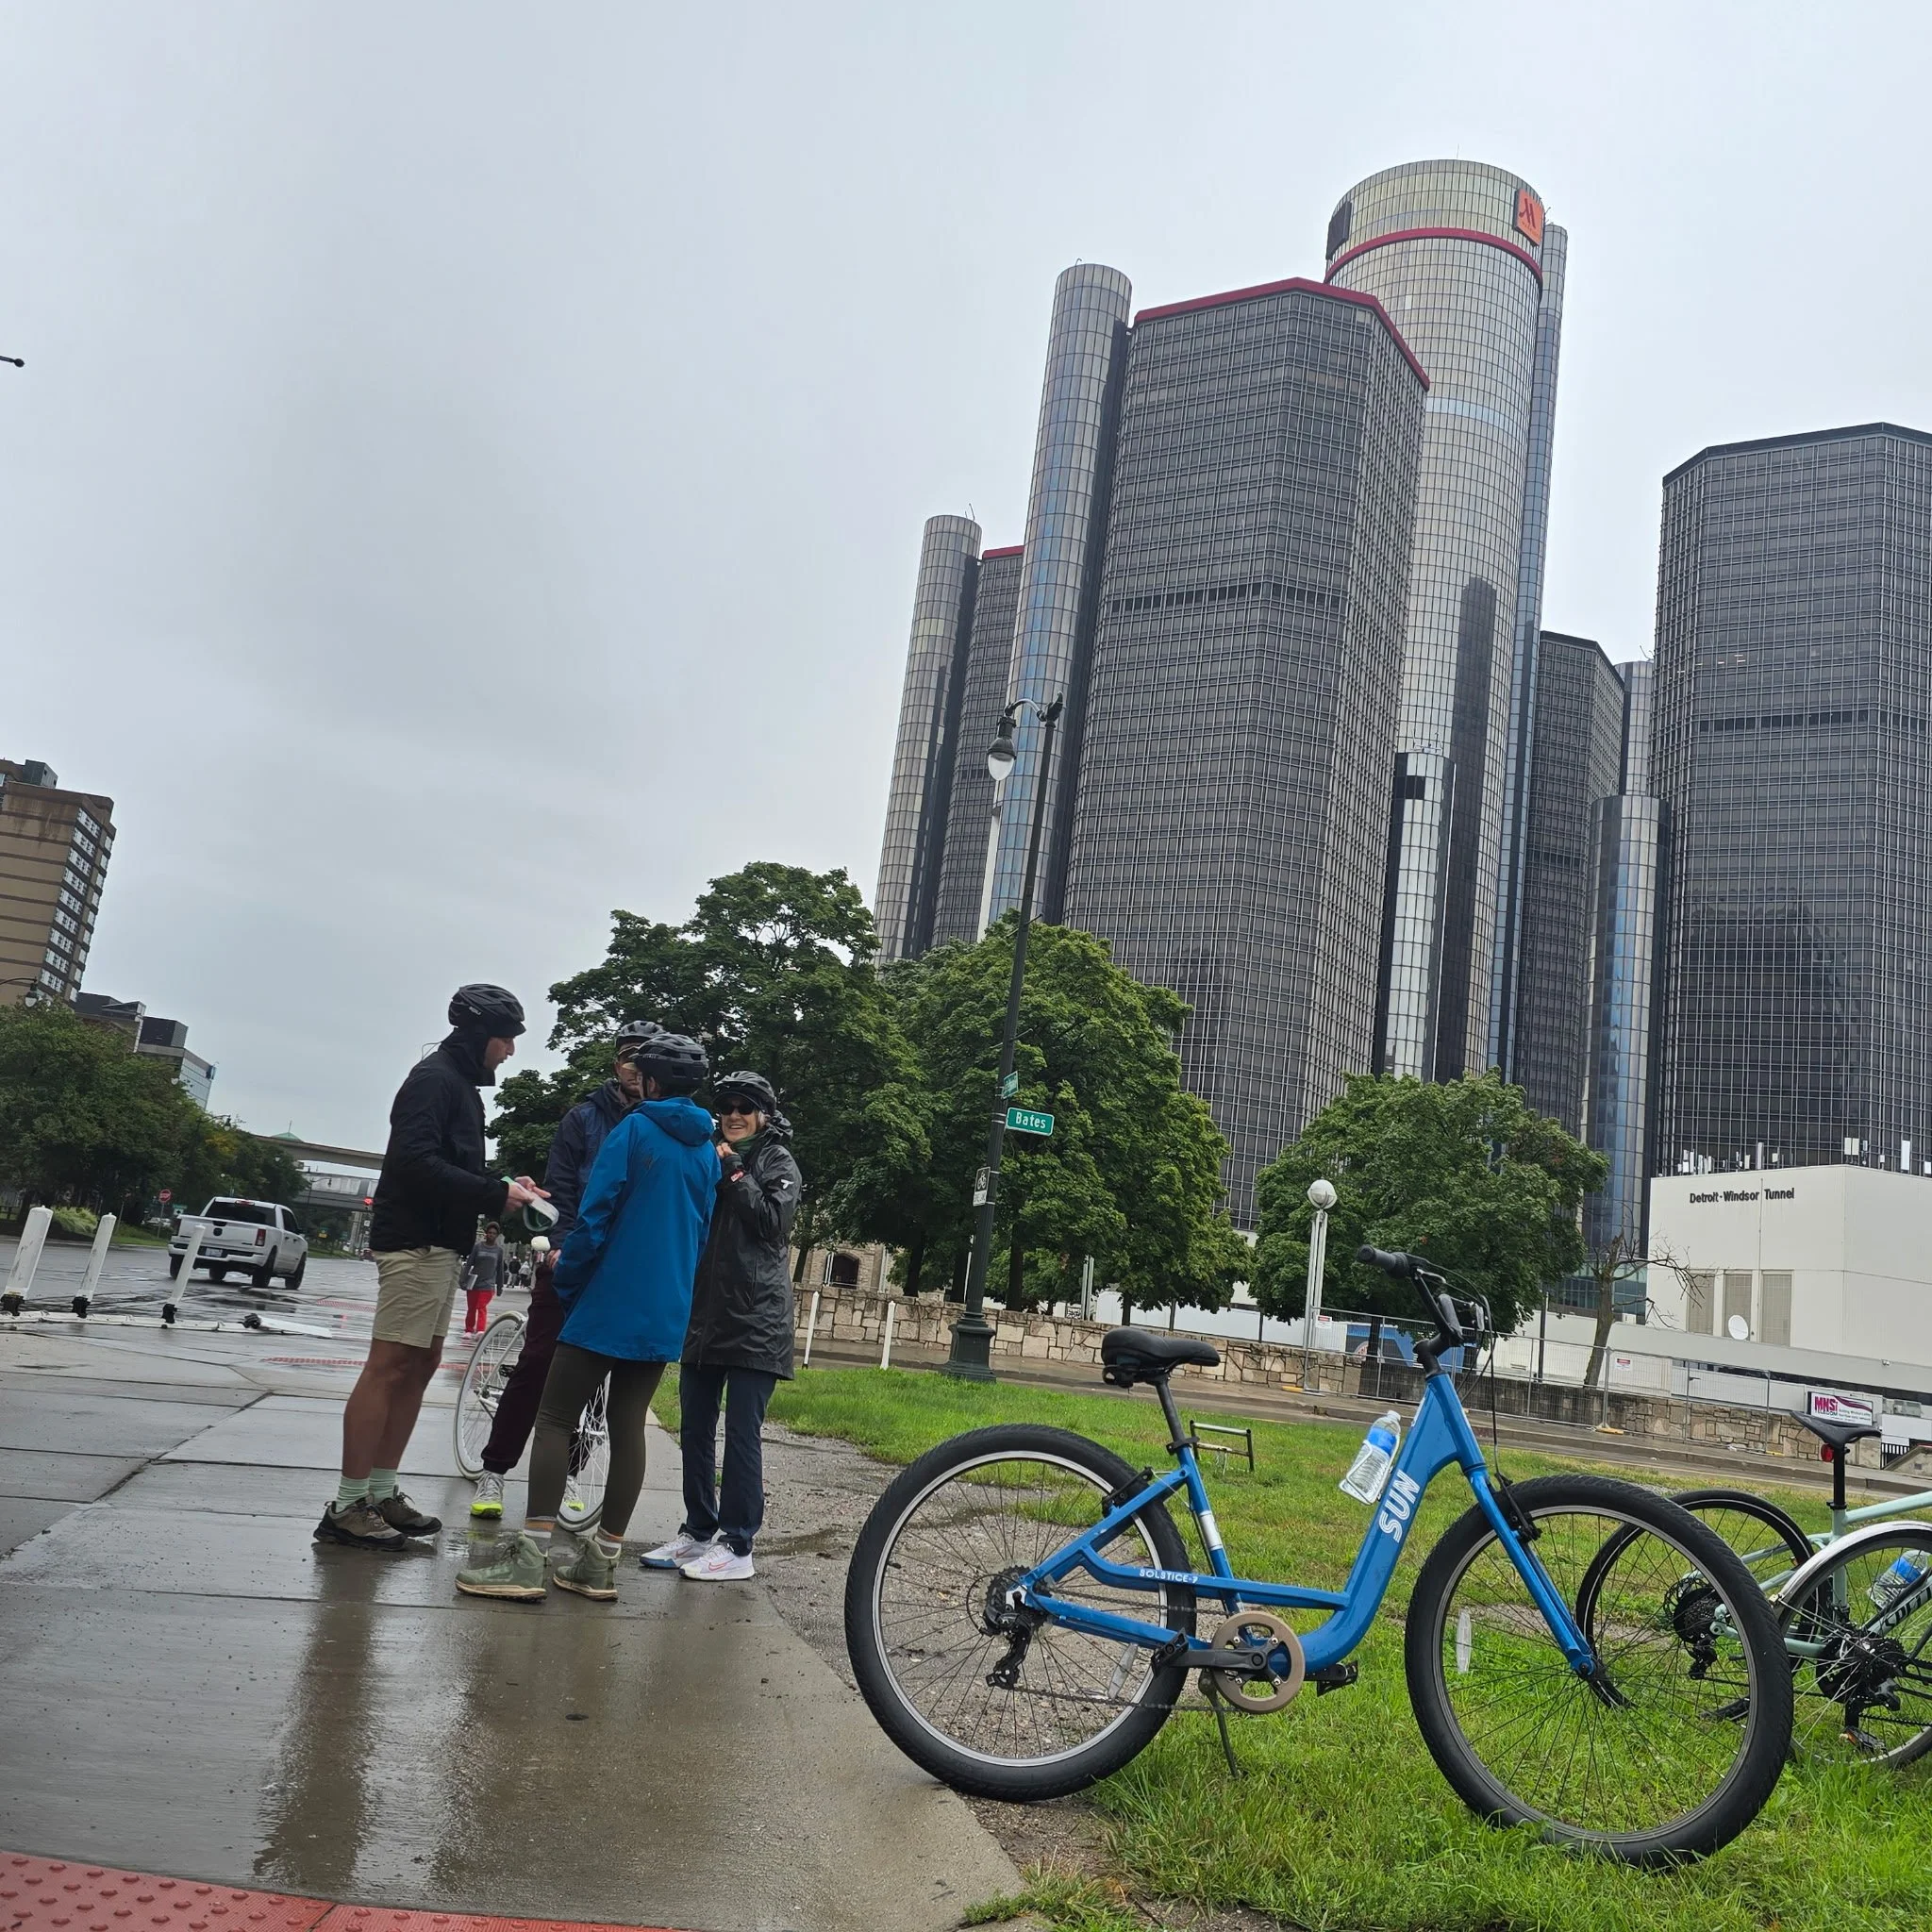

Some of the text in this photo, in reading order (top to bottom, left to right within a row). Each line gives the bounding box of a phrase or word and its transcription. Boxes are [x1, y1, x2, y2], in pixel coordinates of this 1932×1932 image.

[1015, 1111, 1046, 1129] Bates
[1764, 1187, 1795, 1200] Tunnel
[1378, 1469, 1421, 1543] SUN
[1139, 1568, 1199, 1584] SOLSTICE-7
